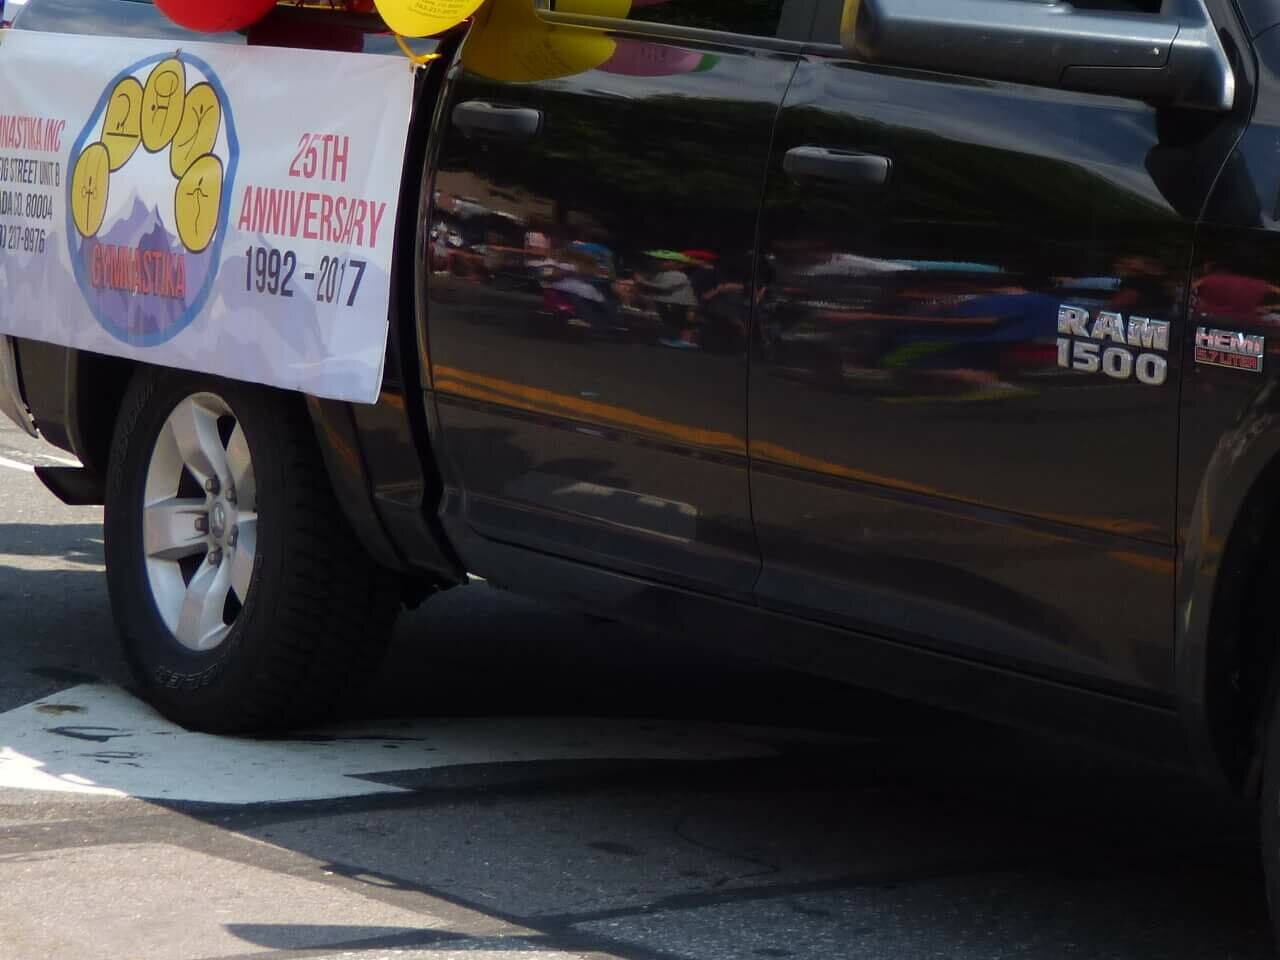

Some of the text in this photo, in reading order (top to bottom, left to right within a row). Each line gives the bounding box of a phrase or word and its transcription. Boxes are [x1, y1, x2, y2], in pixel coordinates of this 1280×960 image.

[44, 119, 65, 152] INC
[10, 159, 38, 185] STREET
[39, 161, 54, 187] UNIT
[55, 162, 61, 187] B
[289, 133, 349, 182] 25TH
[26, 194, 53, 221] 80004
[238, 185, 386, 248] ANNIVERSARY
[1057, 304, 1170, 351] RAM
[1196, 327, 1264, 354] HEMI
[1056, 337, 1168, 386] 1500
